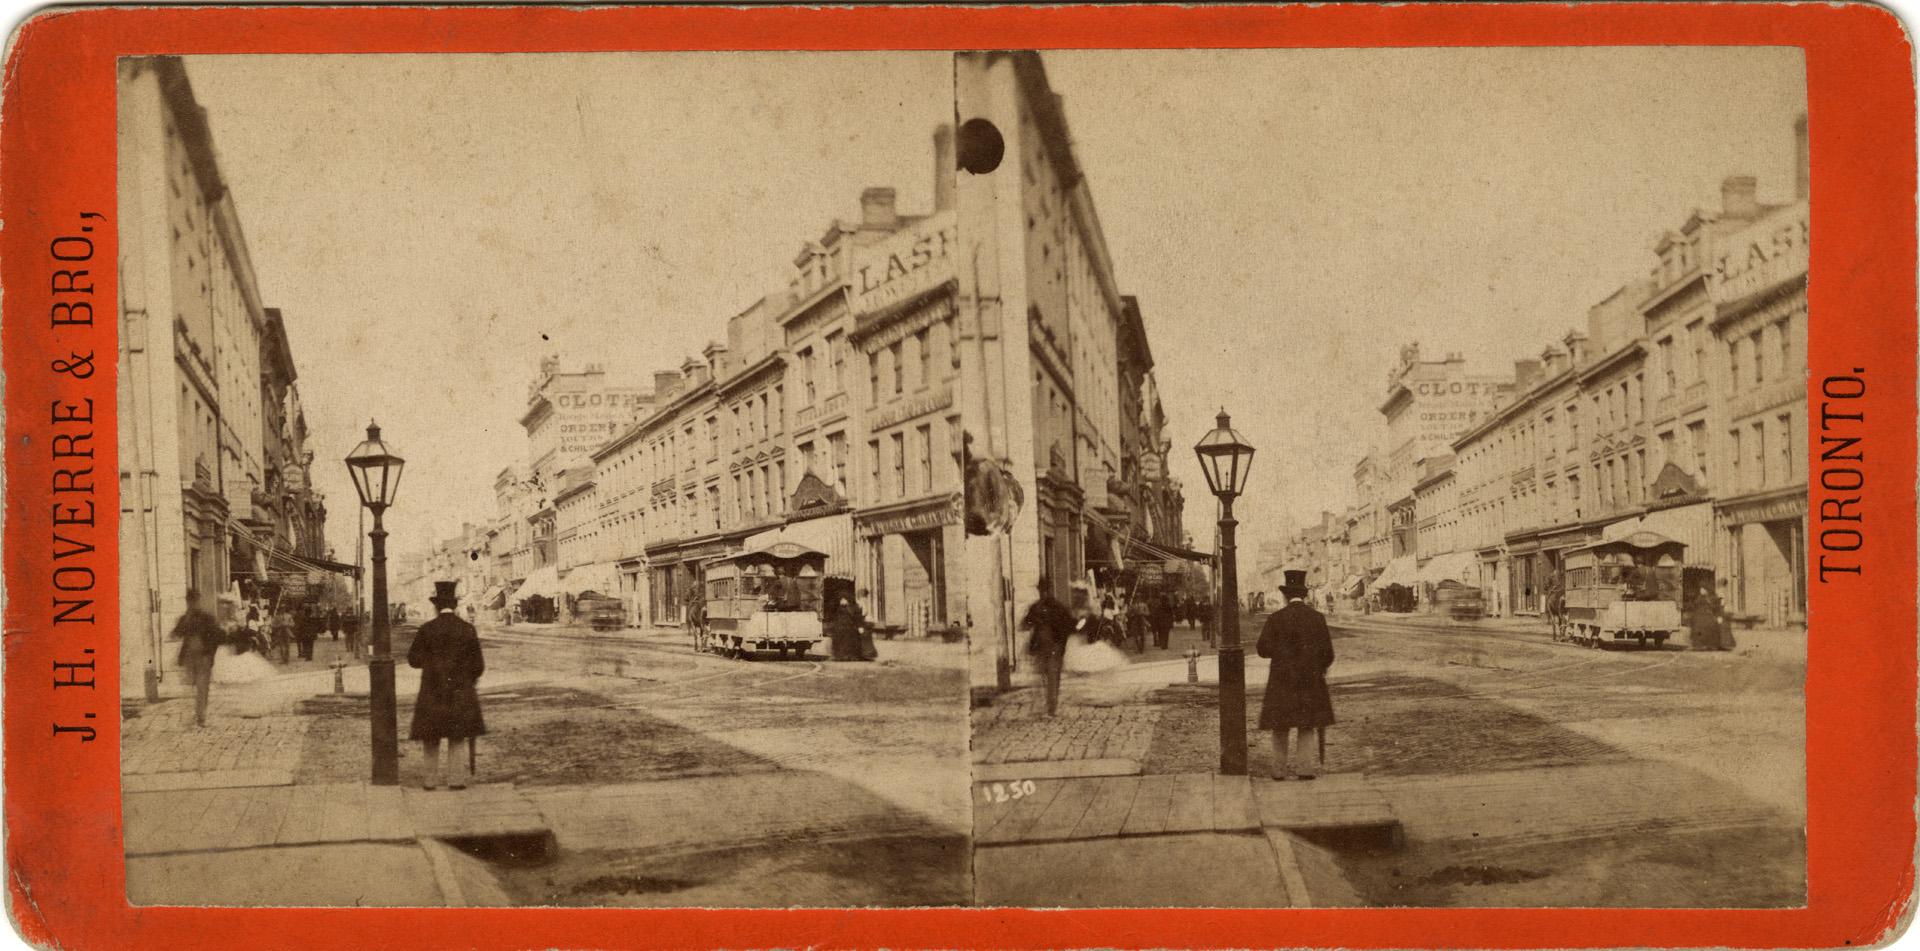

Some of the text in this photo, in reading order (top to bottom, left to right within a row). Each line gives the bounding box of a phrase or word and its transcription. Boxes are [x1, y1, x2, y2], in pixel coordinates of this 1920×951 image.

[50, 212, 103, 743] J. H. NOVERRE & BRO.,
[1819, 367, 1866, 584] TORONTO.
[983, 780, 1036, 803] 1250
